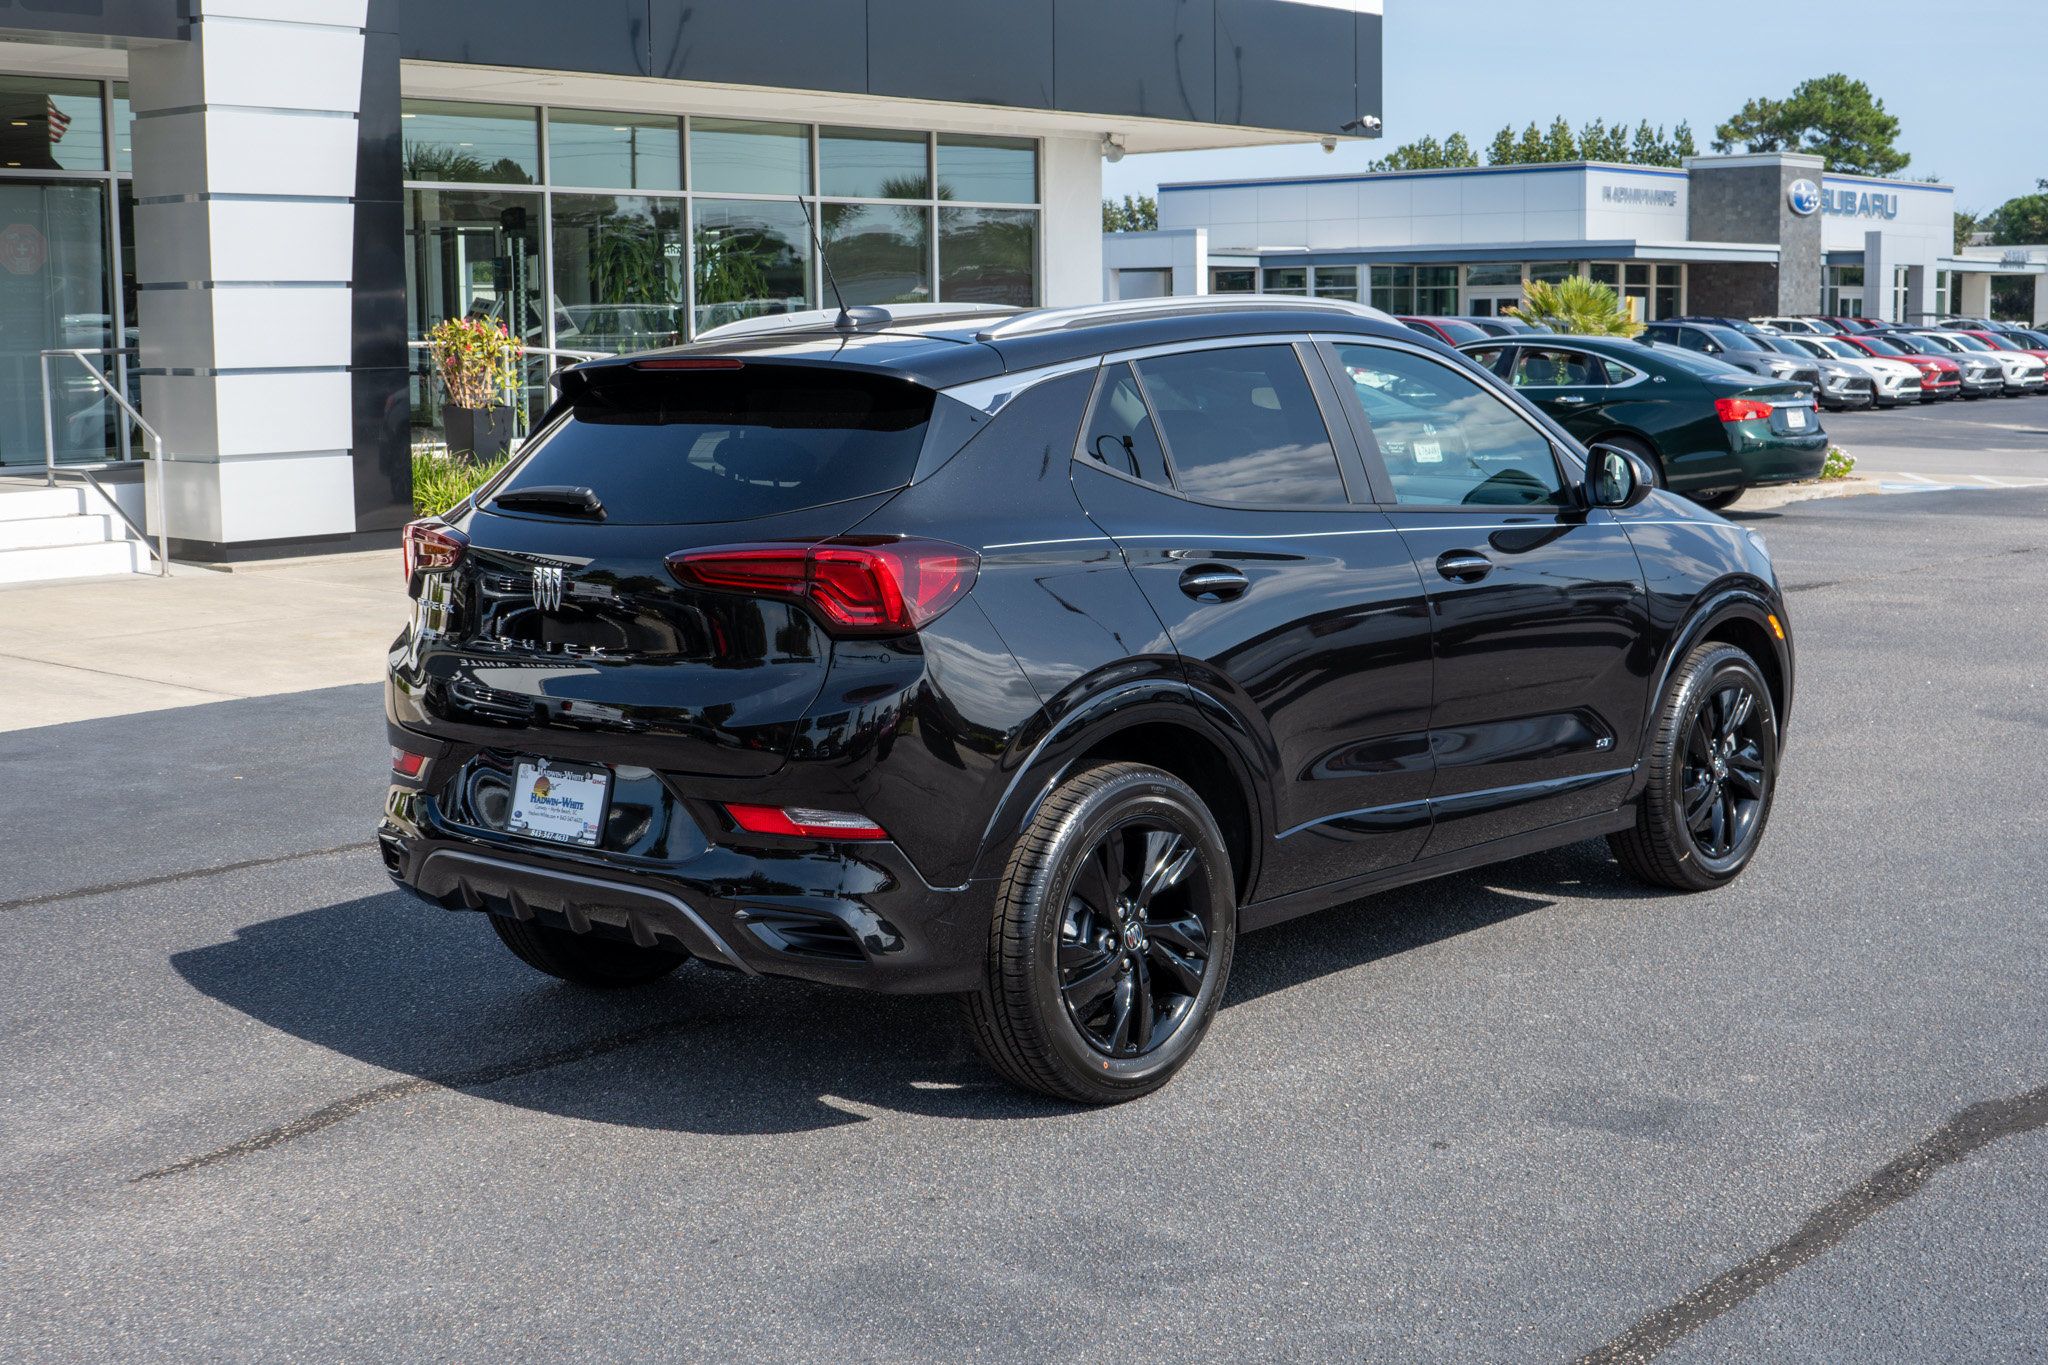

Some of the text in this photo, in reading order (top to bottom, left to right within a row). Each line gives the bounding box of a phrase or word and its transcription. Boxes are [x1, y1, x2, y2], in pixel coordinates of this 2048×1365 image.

[1821, 188, 1897, 219] SUBARU
[440, 603, 454, 613] GX
[500, 636, 606, 658] BUICK
[530, 792, 584, 810] HADWIN-WHITE
[530, 829, 569, 842] 843-347-4633
